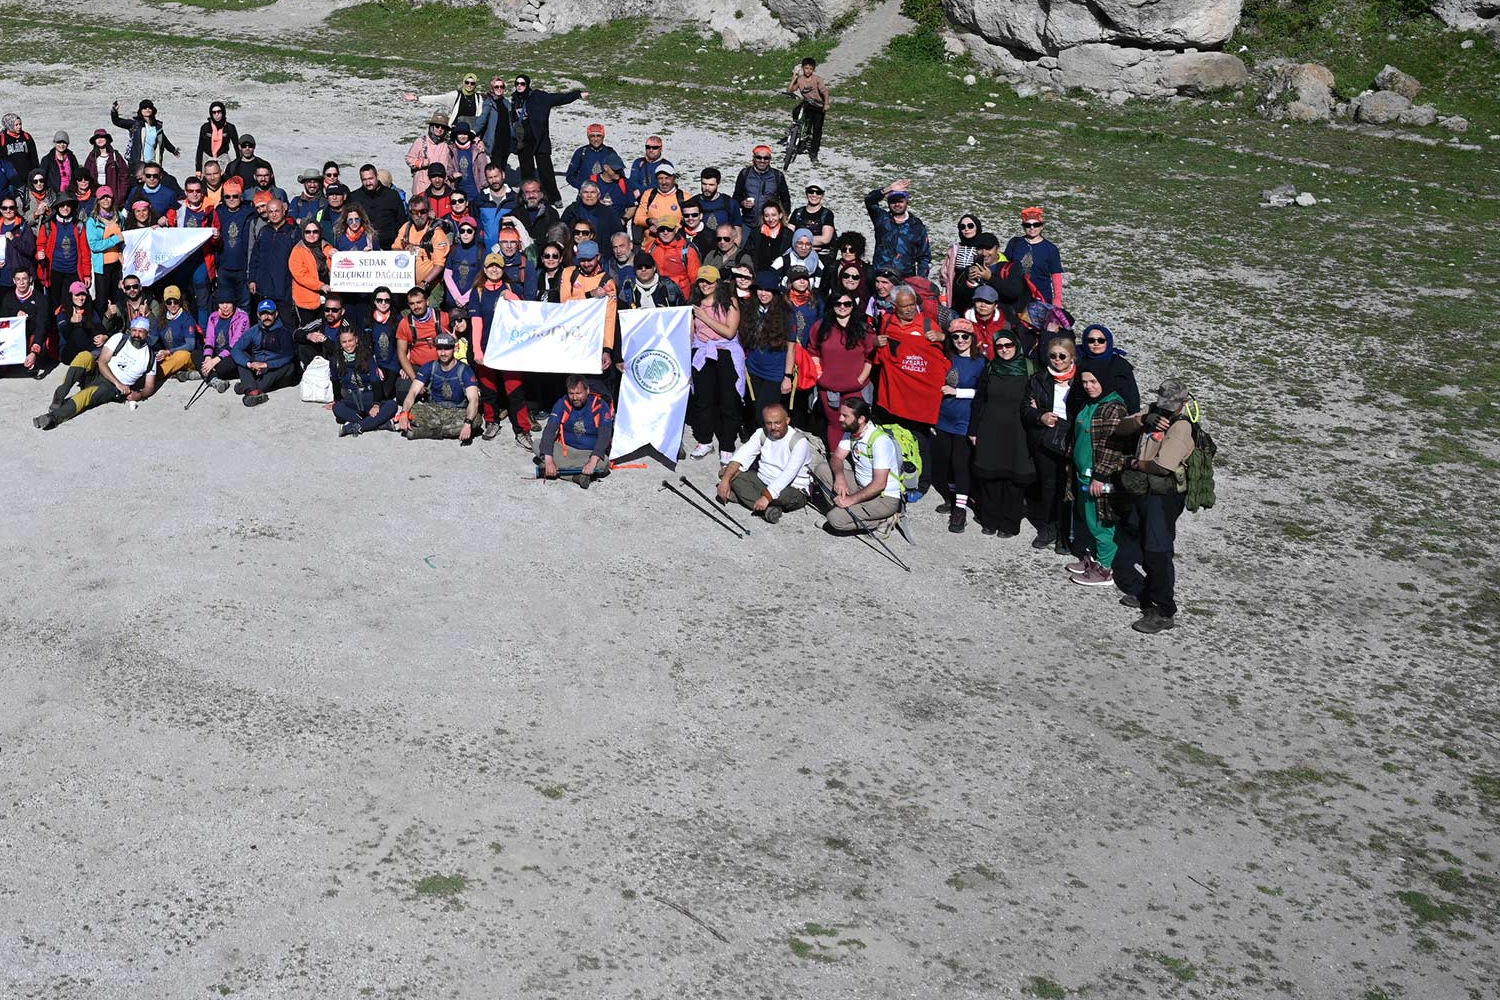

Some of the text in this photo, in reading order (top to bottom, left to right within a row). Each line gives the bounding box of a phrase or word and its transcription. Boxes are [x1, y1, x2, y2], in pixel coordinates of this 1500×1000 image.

[359, 258, 387, 267] SEDAK
[333, 269, 412, 280] SELÇUKLU DAĞCILIK
